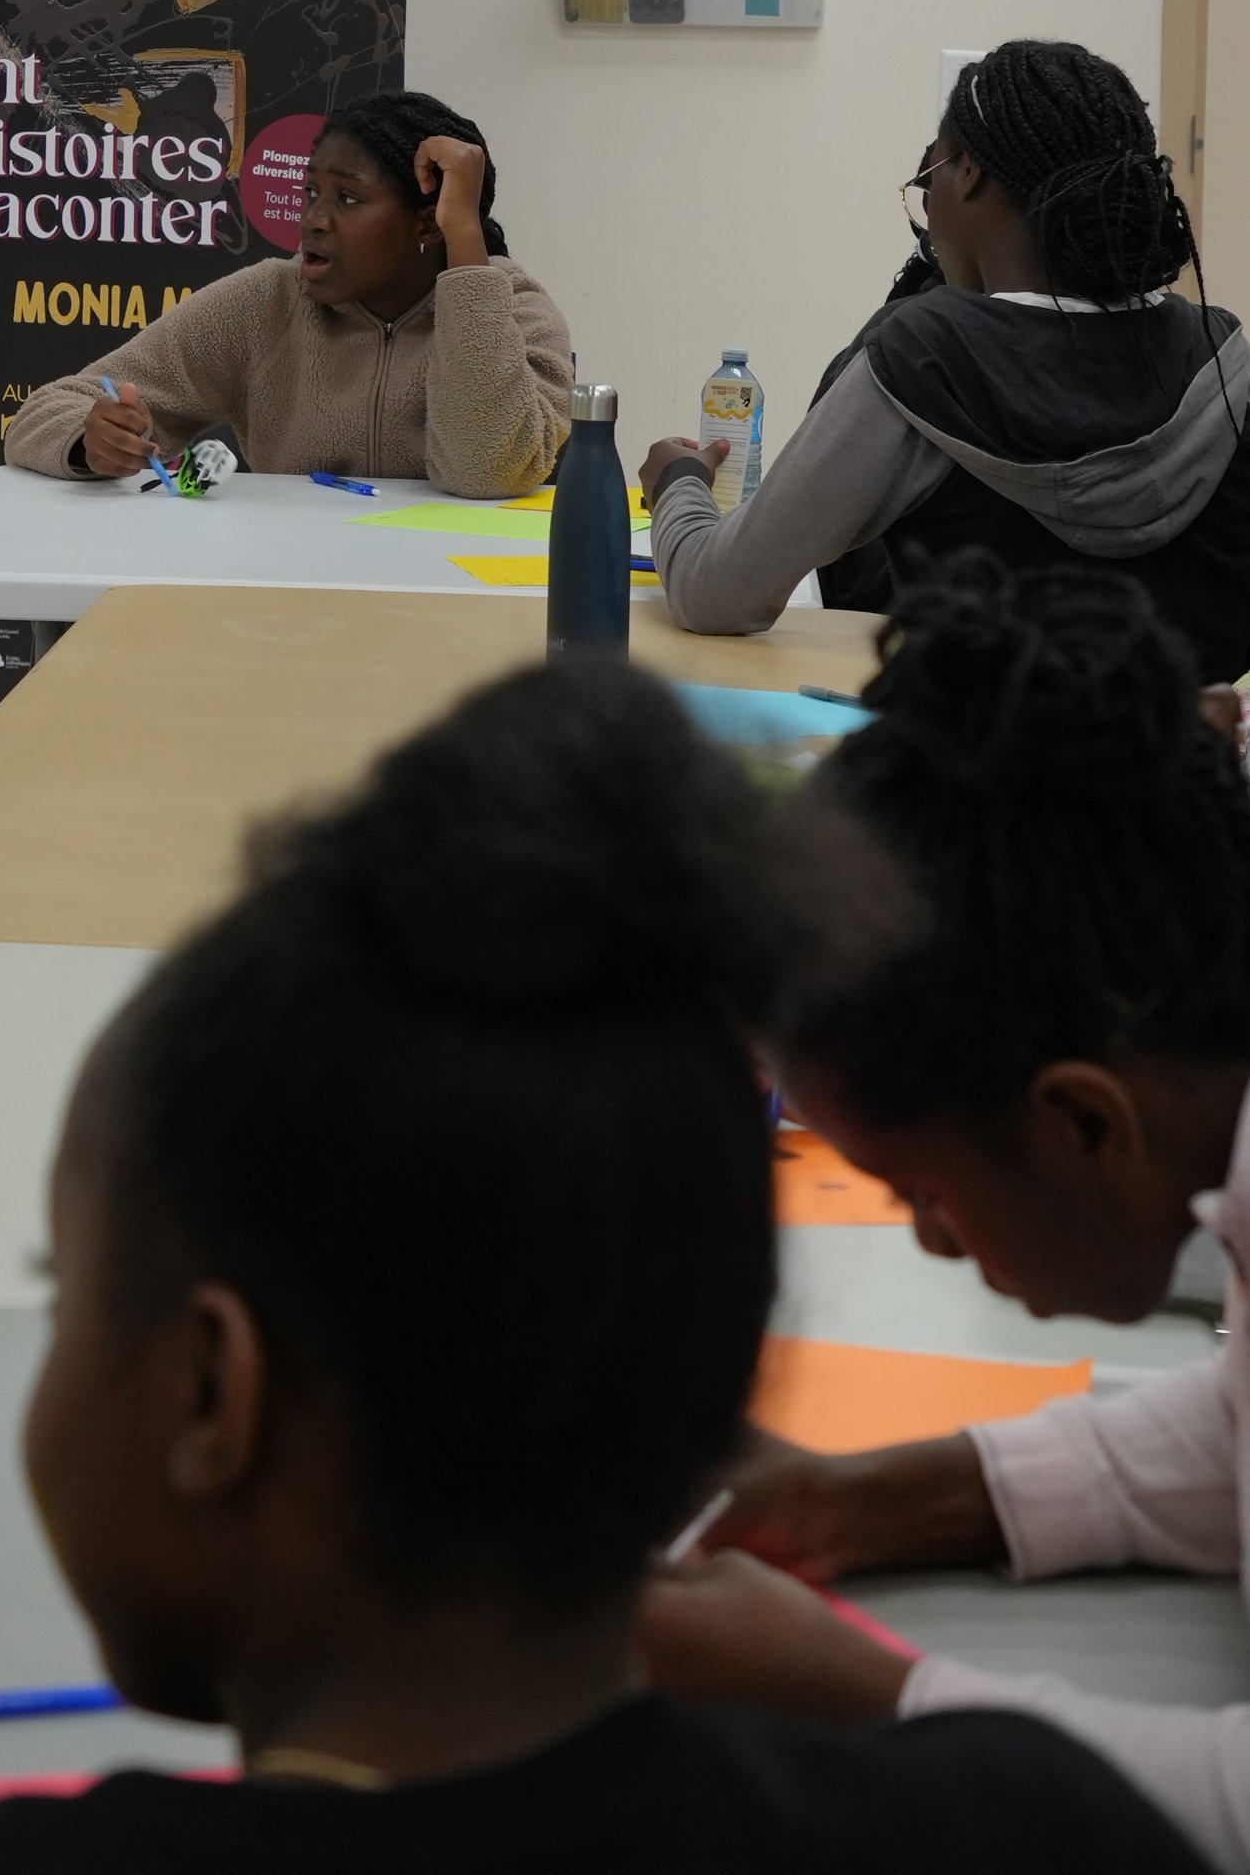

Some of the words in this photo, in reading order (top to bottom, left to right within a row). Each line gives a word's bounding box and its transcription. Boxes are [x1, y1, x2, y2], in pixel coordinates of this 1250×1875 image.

[262, 149, 310, 167] Plongez
[252, 164, 304, 181] diversité
[265, 191, 289, 205] Tout
[292, 194, 302, 206] le
[264, 209, 281, 220] est
[13, 280, 148, 329] MONIA
